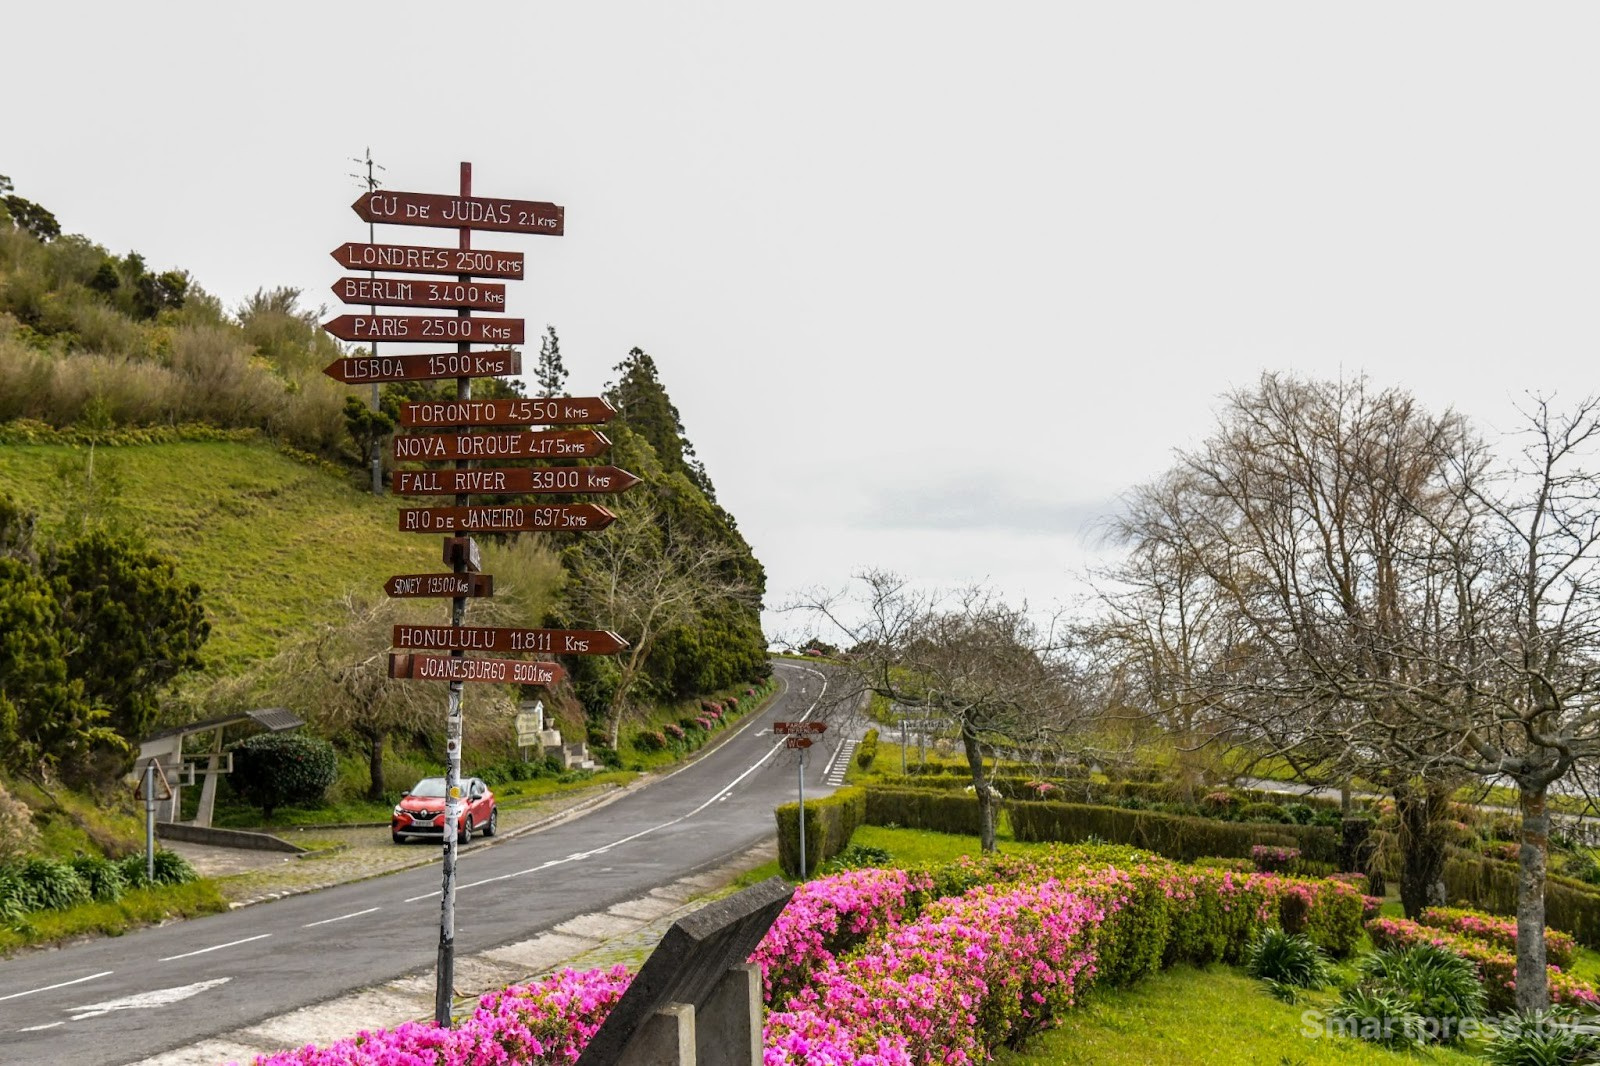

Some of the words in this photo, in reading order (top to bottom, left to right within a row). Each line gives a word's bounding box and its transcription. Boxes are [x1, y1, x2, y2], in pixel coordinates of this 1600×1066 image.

[370, 195, 397, 216] CU
[406, 204, 431, 219] DE
[442, 201, 511, 224] JUDAS
[518, 211, 535, 226] 2.1
[348, 245, 449, 269] LONDRES
[345, 280, 413, 300] BERLIM
[428, 284, 478, 302] 3.400
[354, 318, 408, 336] PARIS
[421, 319, 472, 337] 2.500
[343, 359, 404, 379] LISBOA
[428, 355, 471, 376] 1.500
[408, 403, 496, 423] TORONTO
[508, 402, 558, 420] 4.550
[396, 437, 446, 457] NOVA
[457, 434, 522, 455] IORQUE
[400, 473, 442, 491] FALL
[455, 472, 506, 490] RIVER
[532, 471, 579, 489] 3.900
[406, 510, 430, 529] RIO
[436, 517, 454, 529] DE
[461, 508, 524, 528] JANEIRO
[400, 628, 496, 649] HONULULU
[510, 632, 550, 650] 11.811
[420, 657, 506, 681] JOANESBURGO
